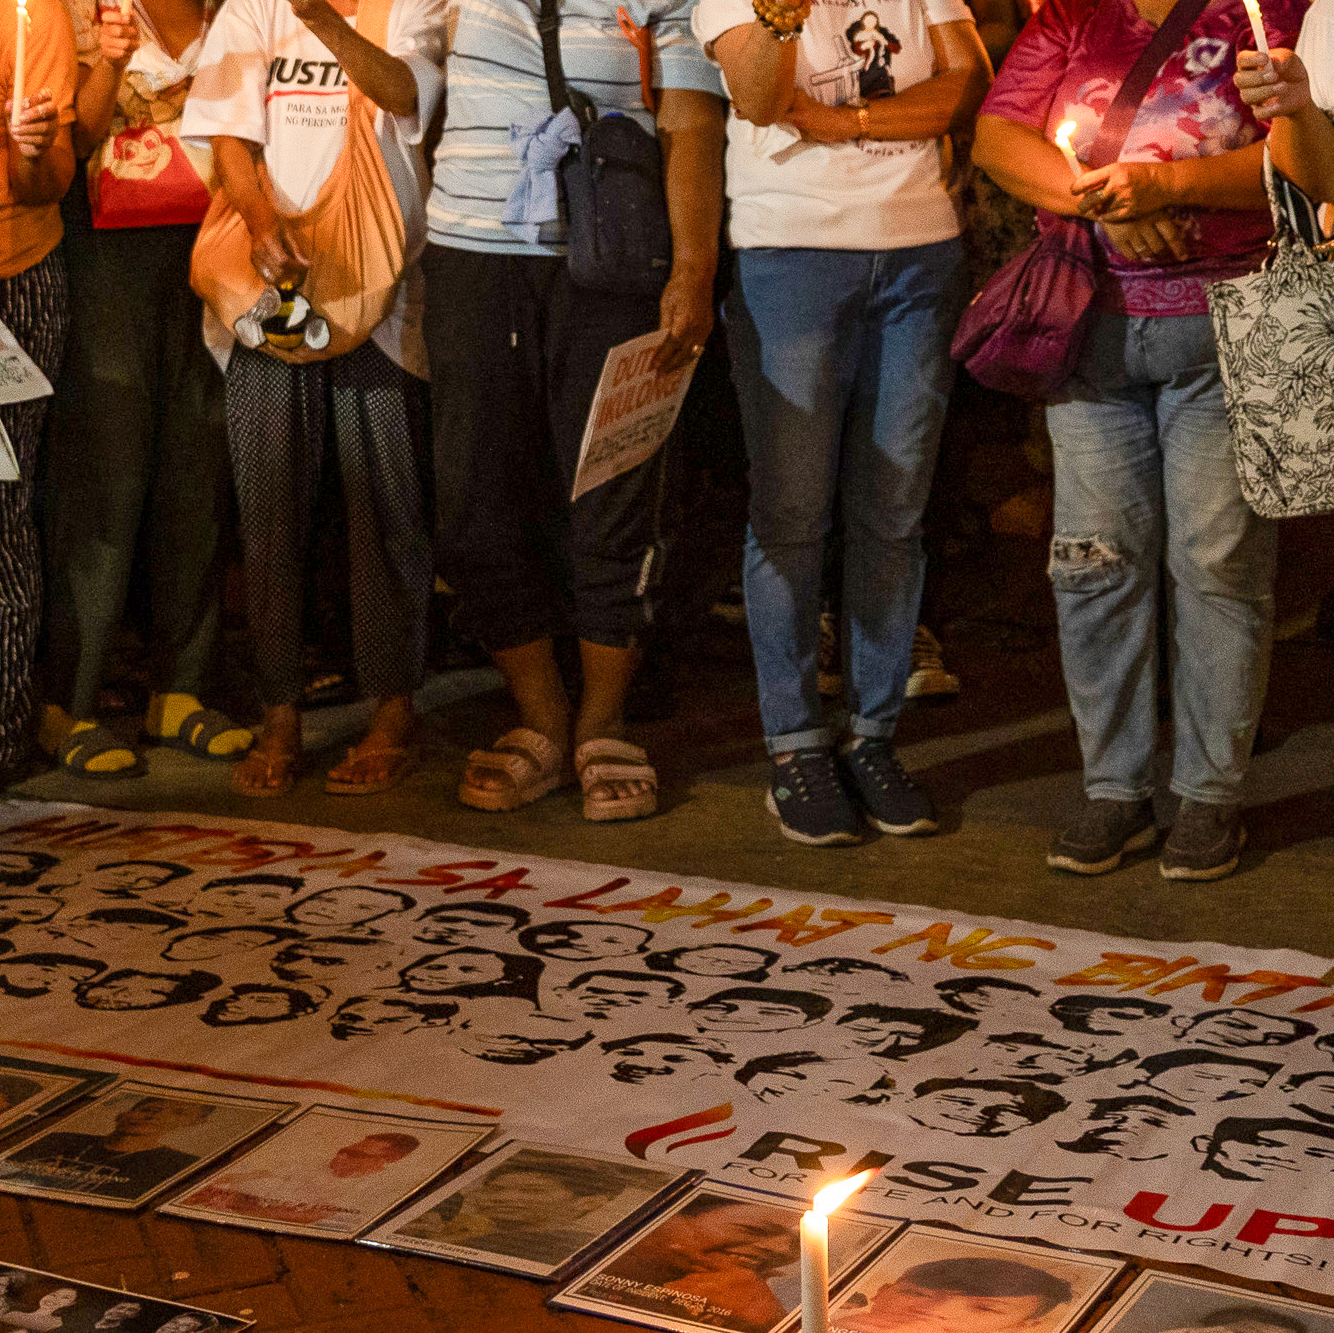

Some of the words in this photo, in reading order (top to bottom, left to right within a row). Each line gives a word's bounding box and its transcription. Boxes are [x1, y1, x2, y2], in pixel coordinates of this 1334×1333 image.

[286, 102, 312, 114] PARA
[315, 105, 328, 115] SA
[721, 1161, 809, 1184] FOR
[922, 1195, 1015, 1220] AND
[1028, 1207, 1122, 1235] FOR
[1137, 1227, 1329, 1272] RIGHTS!
[595, 1272, 643, 1290] SONNY
[643, 1282, 708, 1305] ESPINOSA
